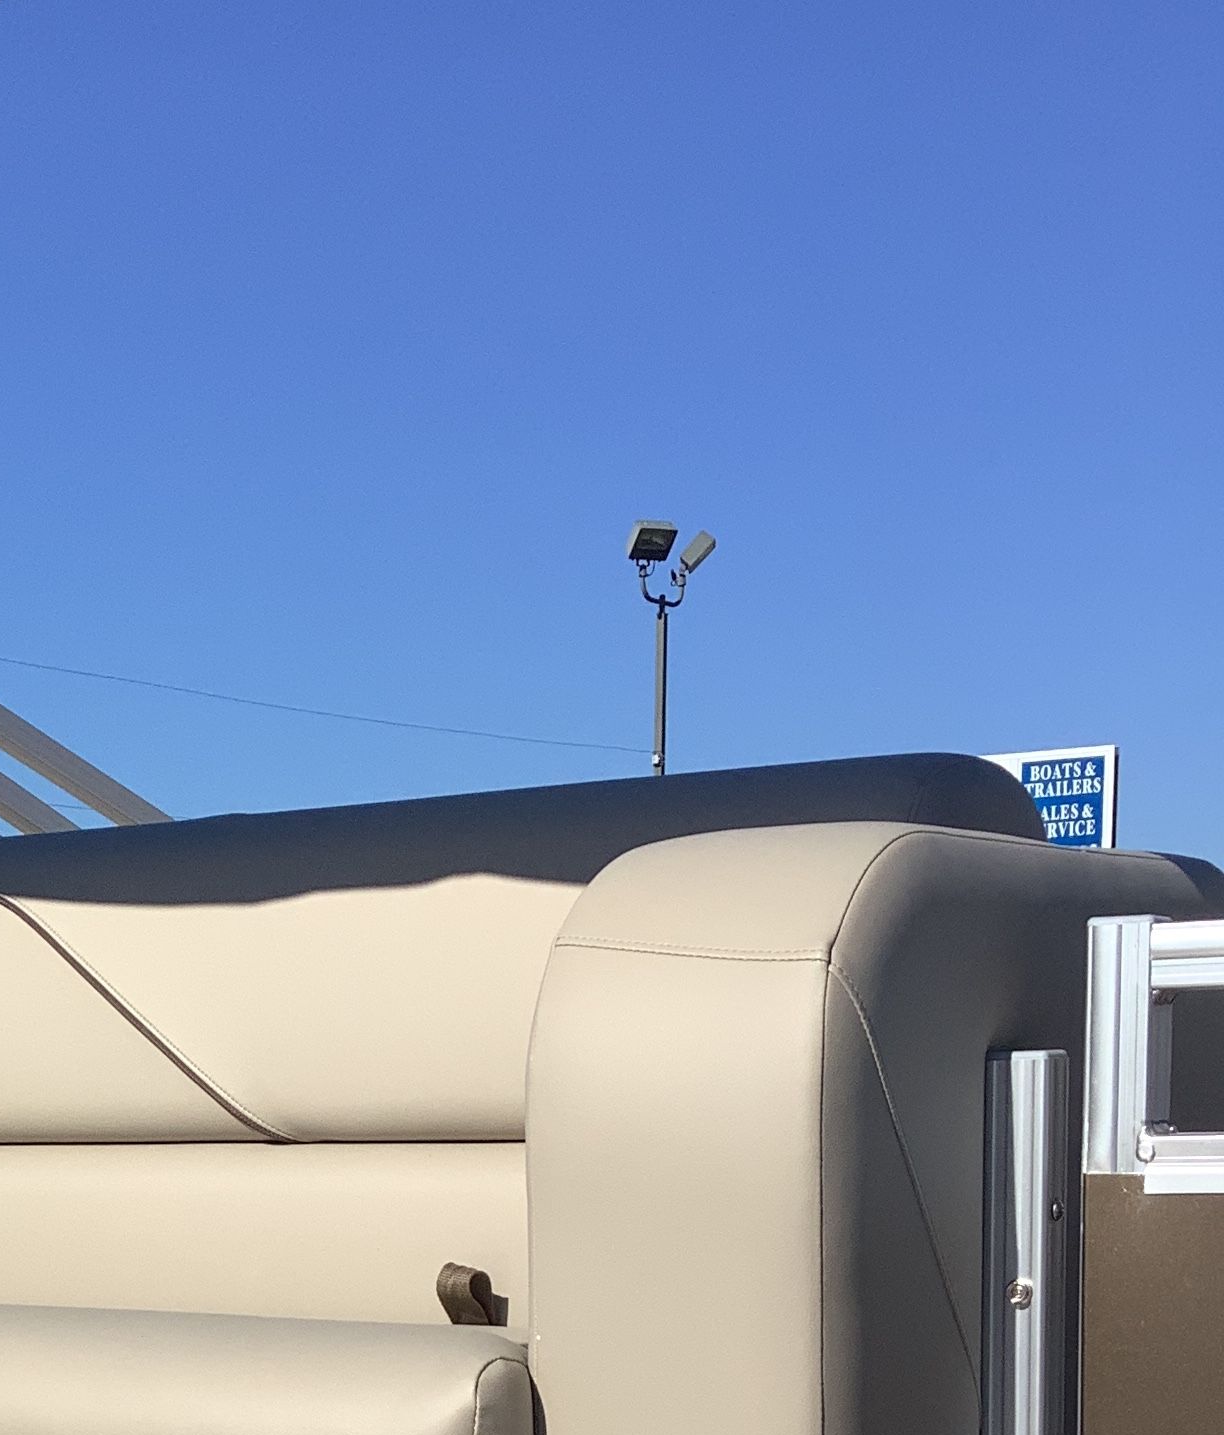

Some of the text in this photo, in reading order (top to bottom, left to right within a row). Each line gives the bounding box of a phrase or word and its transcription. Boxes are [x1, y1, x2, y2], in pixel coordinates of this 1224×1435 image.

[1030, 761, 1096, 781] BOATS &
[1041, 803, 1094, 821] ALES &
[1044, 820, 1096, 839] RVICE
